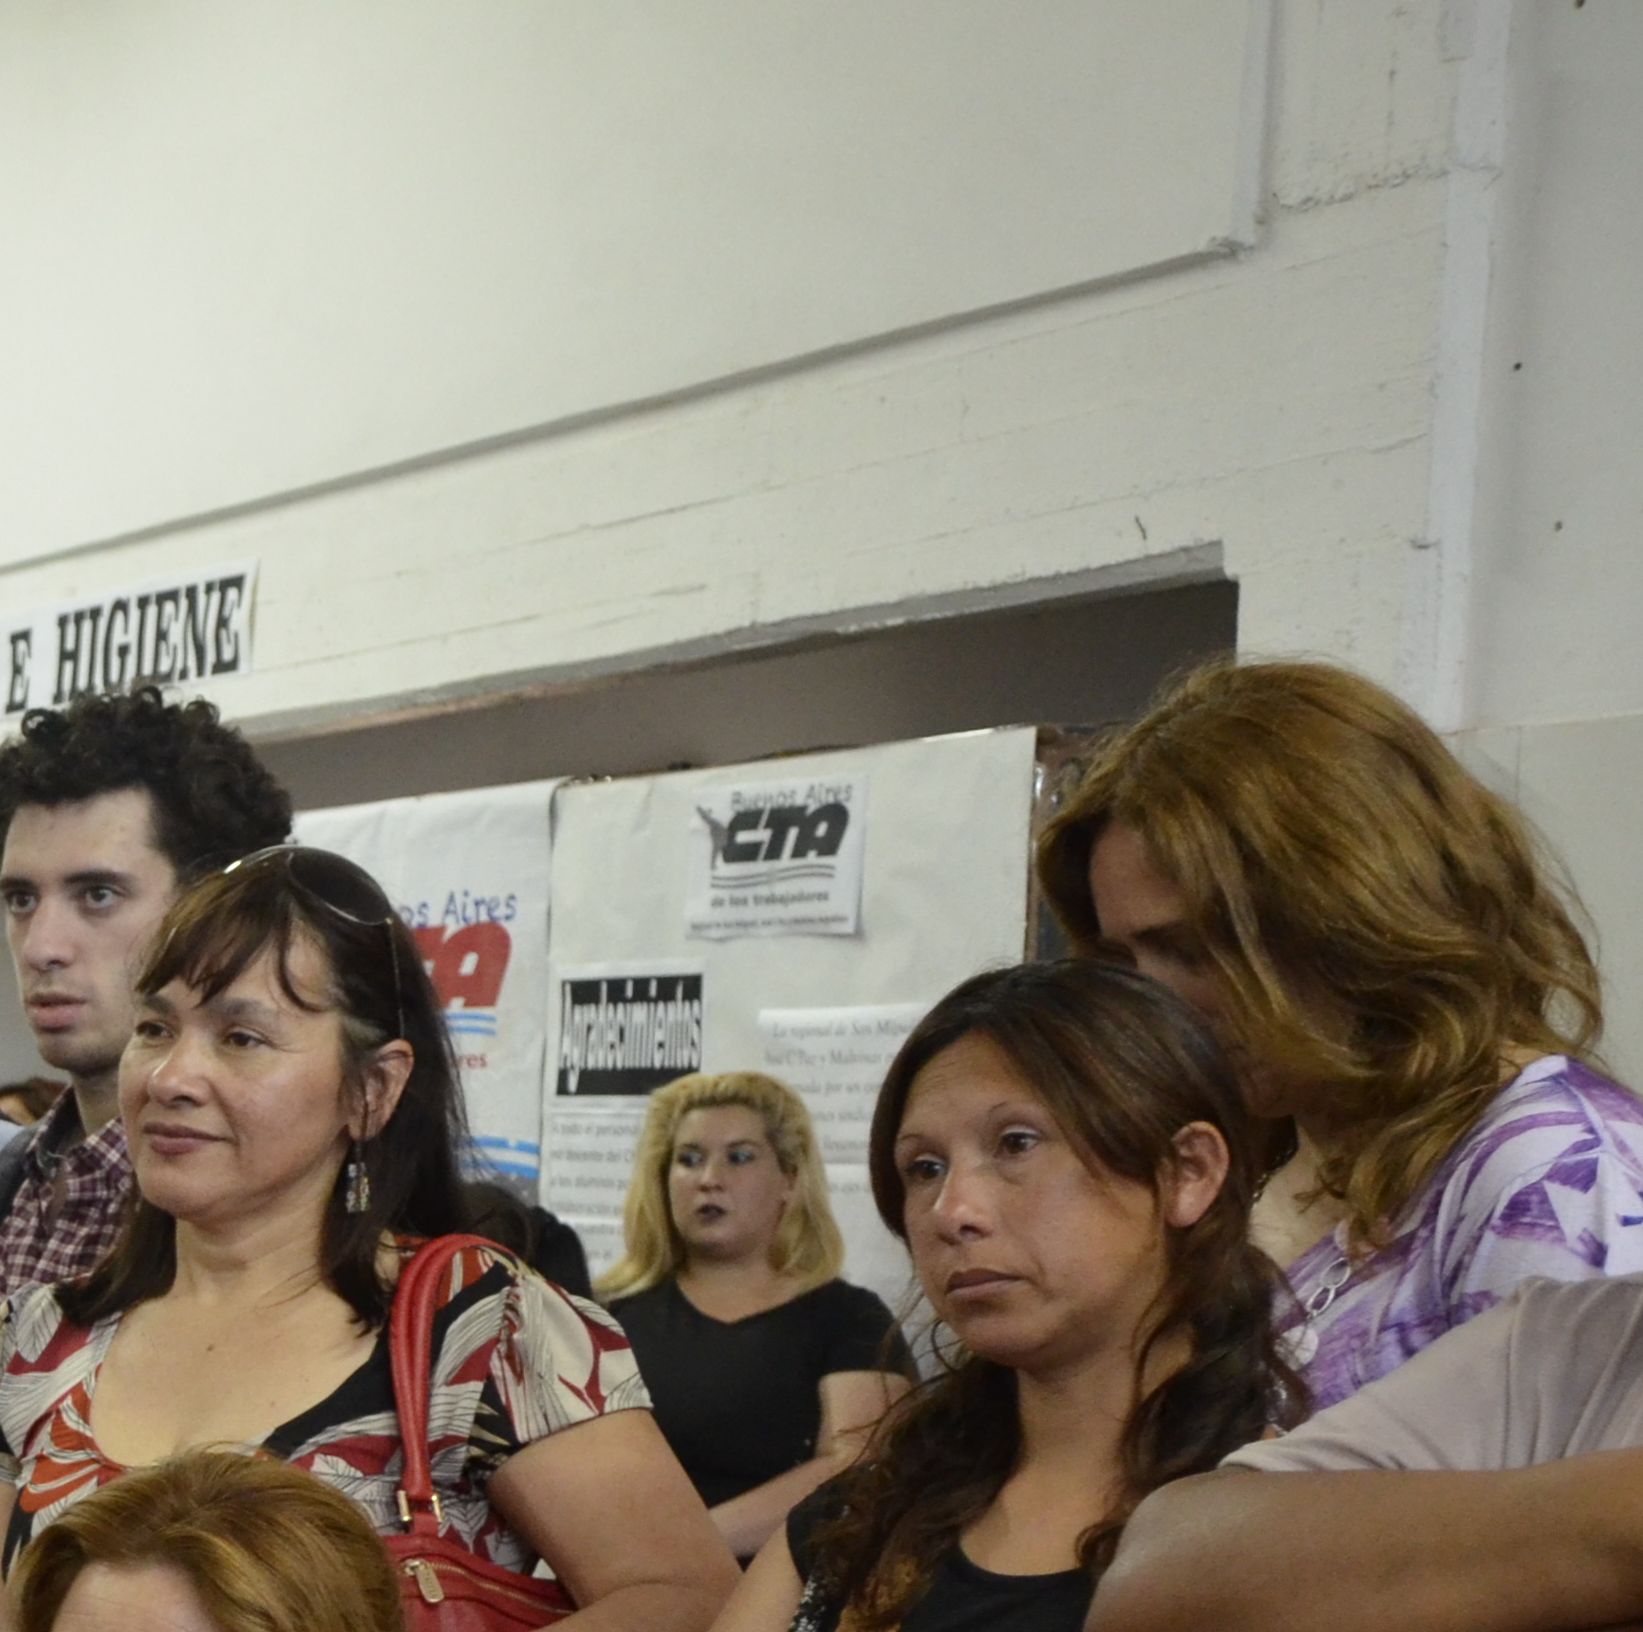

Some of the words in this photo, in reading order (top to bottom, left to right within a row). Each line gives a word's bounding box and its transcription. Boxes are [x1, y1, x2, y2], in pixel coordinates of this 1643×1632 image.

[5, 628, 33, 714] E
[53, 573, 247, 705] HIGIENE
[730, 789, 797, 811] Buenos
[804, 783, 853, 805] Aires
[722, 802, 849, 864] CTA
[442, 888, 517, 926] Aires
[558, 977, 701, 1095] Agradecimientos
